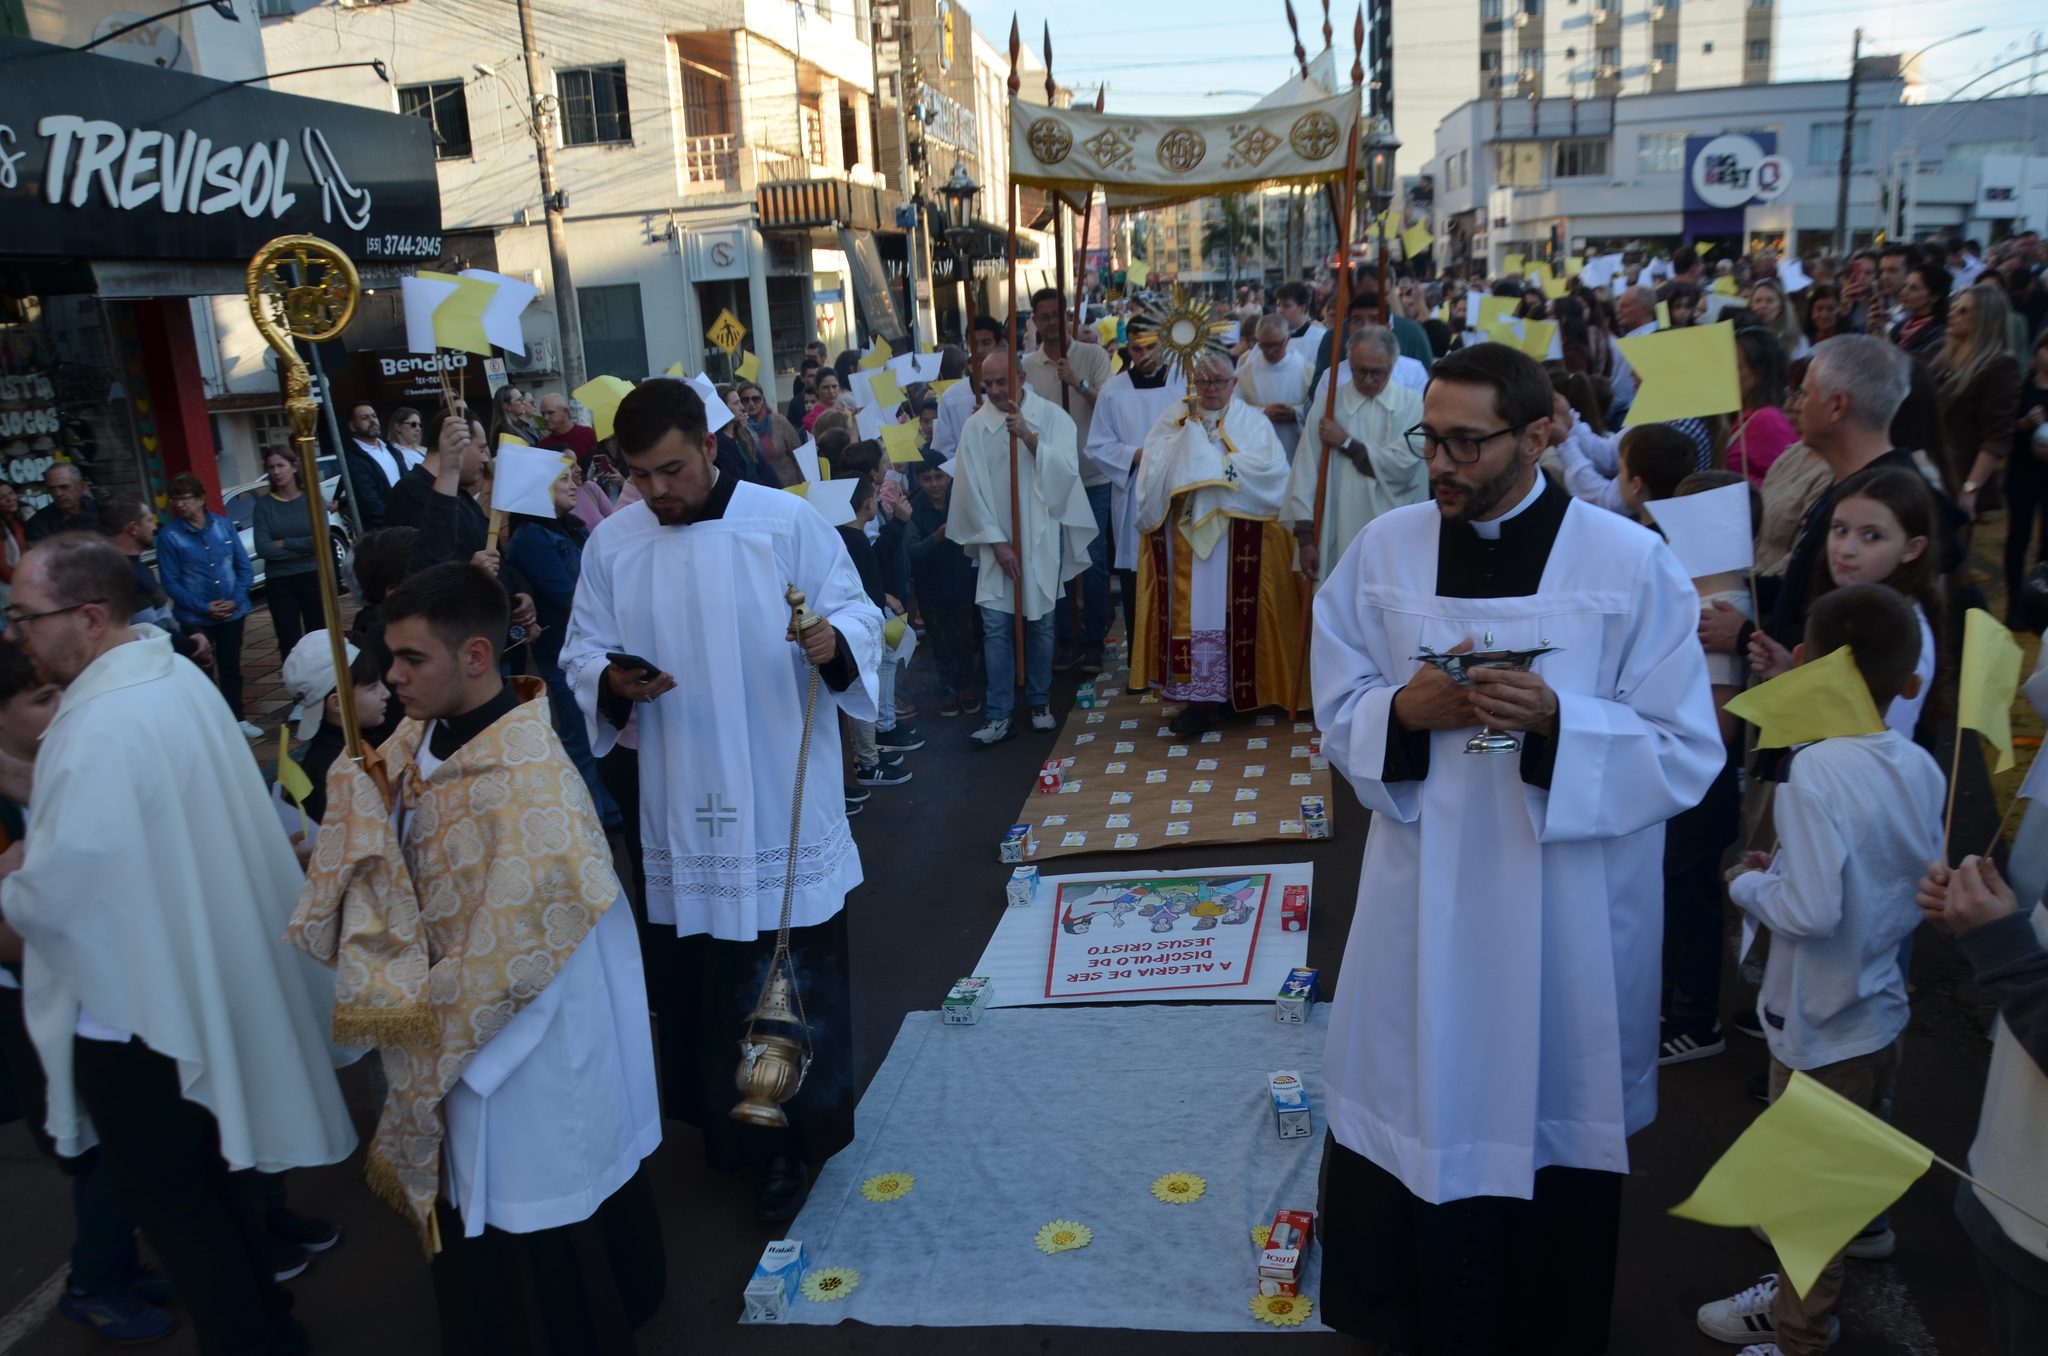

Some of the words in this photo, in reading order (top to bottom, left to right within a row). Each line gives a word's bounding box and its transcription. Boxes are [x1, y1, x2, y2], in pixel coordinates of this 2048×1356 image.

[872, 0, 901, 109] TEL
[37, 114, 296, 219] TREVISOL
[384, 234, 442, 256] 3744-2945
[0, 407, 61, 437] JOGOS
[9, 455, 54, 484] COP
[1087, 942, 1152, 955] CRISTO
[1157, 937, 1215, 950] JESUS
[1088, 958, 1112, 968] DE
[1116, 950, 1212, 965] DISCÍPULO
[1138, 962, 1214, 977] ALEGRIA
[1219, 961, 1232, 971] A
[1067, 971, 1103, 982] SER
[1108, 970, 1131, 979] DE
[1264, 1253, 1296, 1264] TIROL
